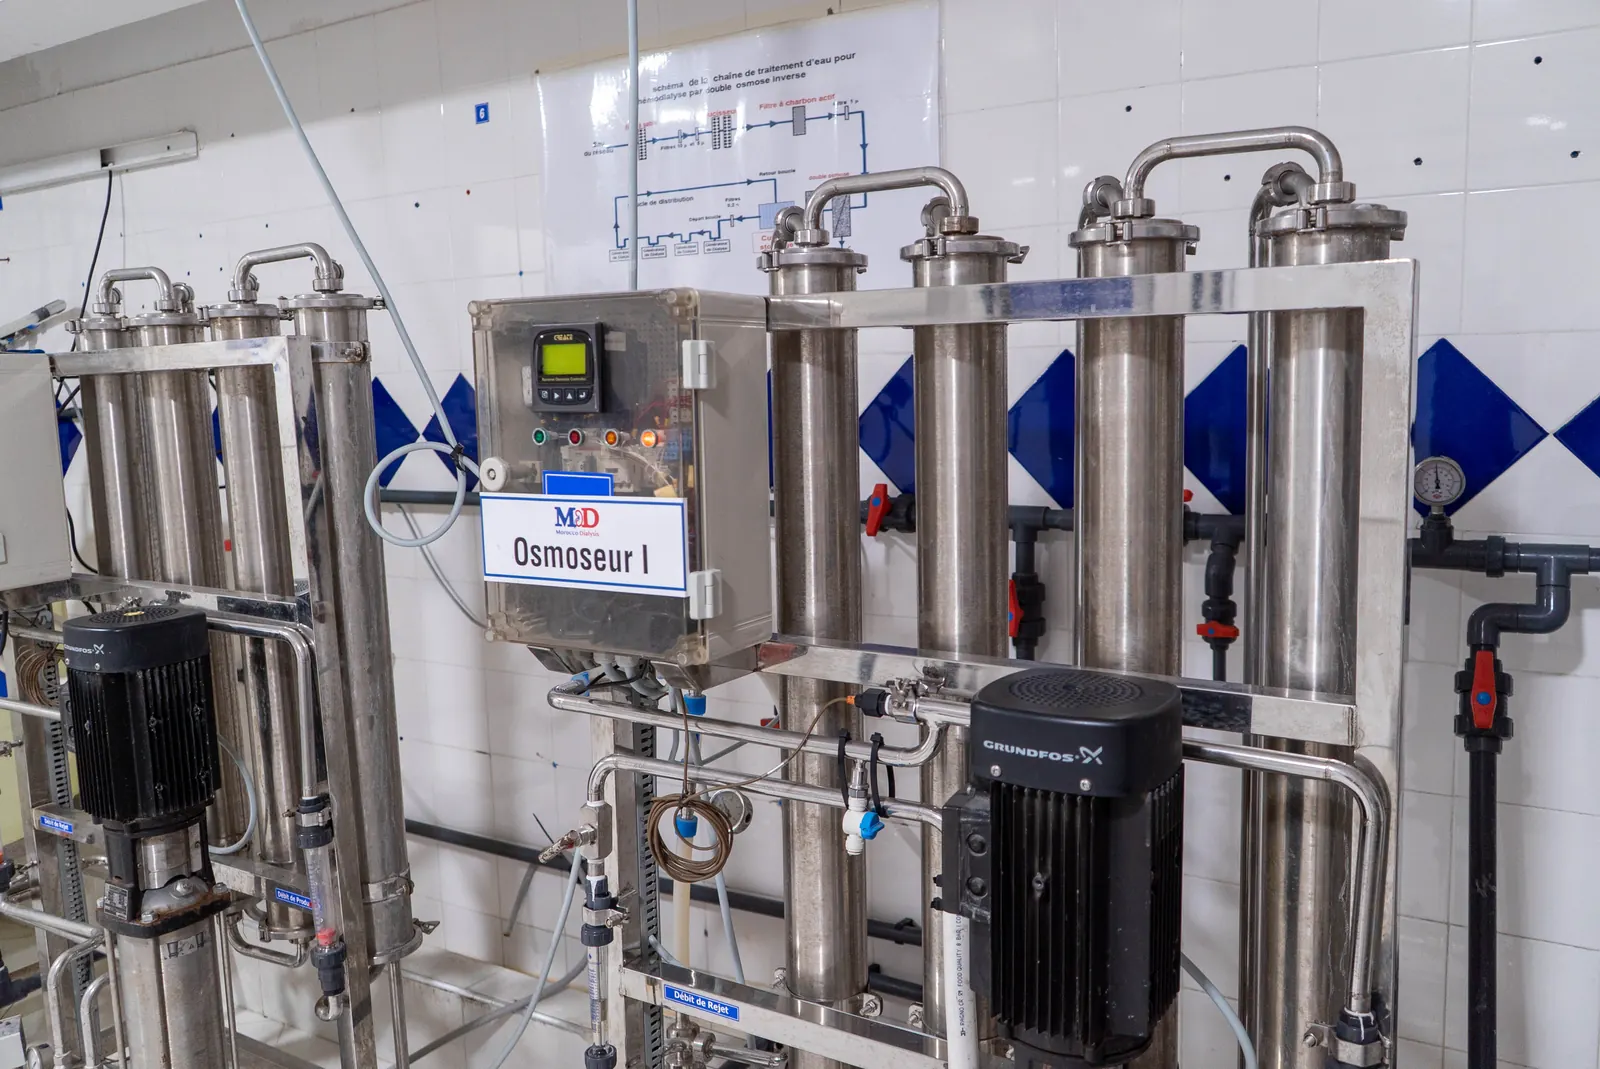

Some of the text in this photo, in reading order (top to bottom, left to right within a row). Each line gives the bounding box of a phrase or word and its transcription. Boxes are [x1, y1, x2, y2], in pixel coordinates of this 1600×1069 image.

[652, 81, 684, 92] schéma
[688, 79, 699, 87] de
[713, 71, 743, 82] chaîne
[745, 69, 755, 77] de
[758, 61, 803, 75] traitement
[805, 57, 832, 67] d'eau
[834, 52, 856, 64] pour
[689, 89, 703, 98] par
[736, 78, 770, 89] osmose
[772, 71, 806, 82] inverse
[479, 107, 485, 119] 6
[759, 102, 777, 111] Filtre
[785, 97, 816, 106] charbon
[819, 93, 836, 101] actif
[658, 196, 694, 205] distribution
[579, 530, 600, 538] Dialysis
[514, 536, 633, 574] Osmoseur
[983, 740, 1074, 763] GRUNDFOS
[673, 990, 729, 1014] Débit de Rejet
